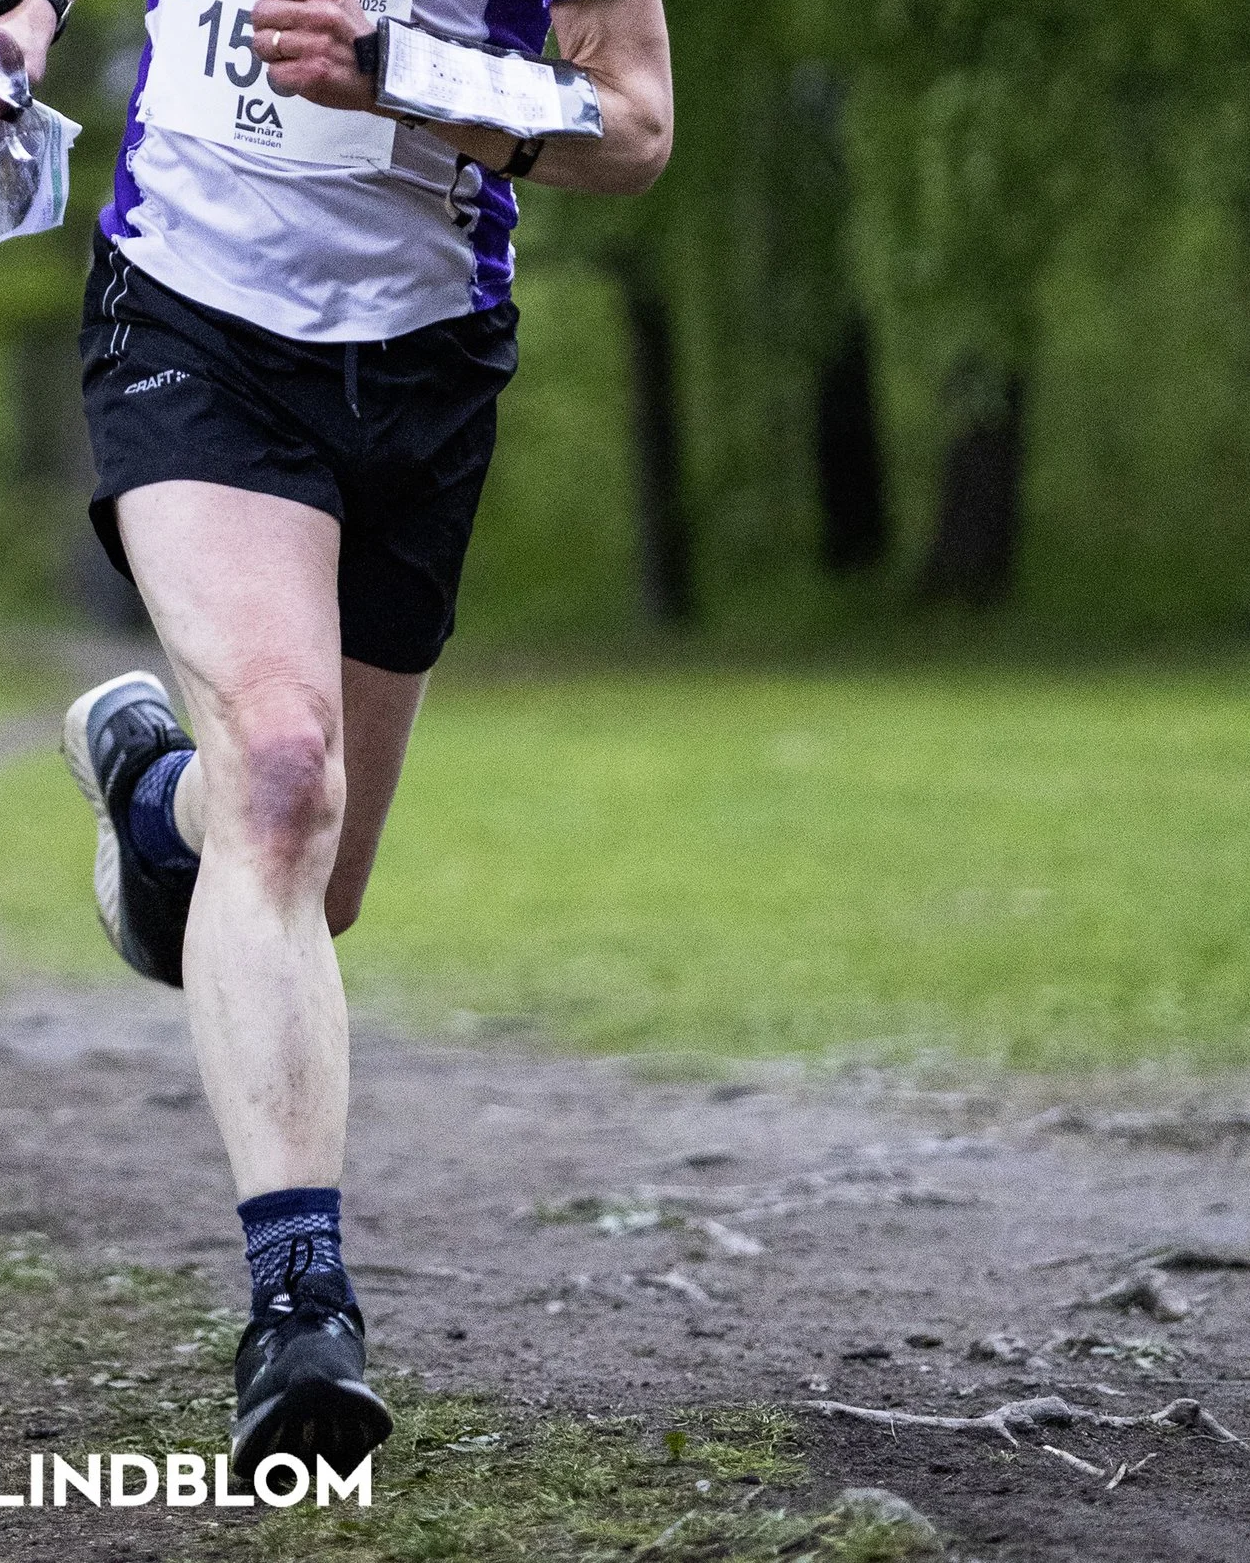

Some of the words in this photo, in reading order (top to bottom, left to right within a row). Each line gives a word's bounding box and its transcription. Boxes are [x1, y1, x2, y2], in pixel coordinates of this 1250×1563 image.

[236, 94, 283, 129] ICA
[257, 125, 283, 139] nära
[124, 369, 174, 395] CRAFT
